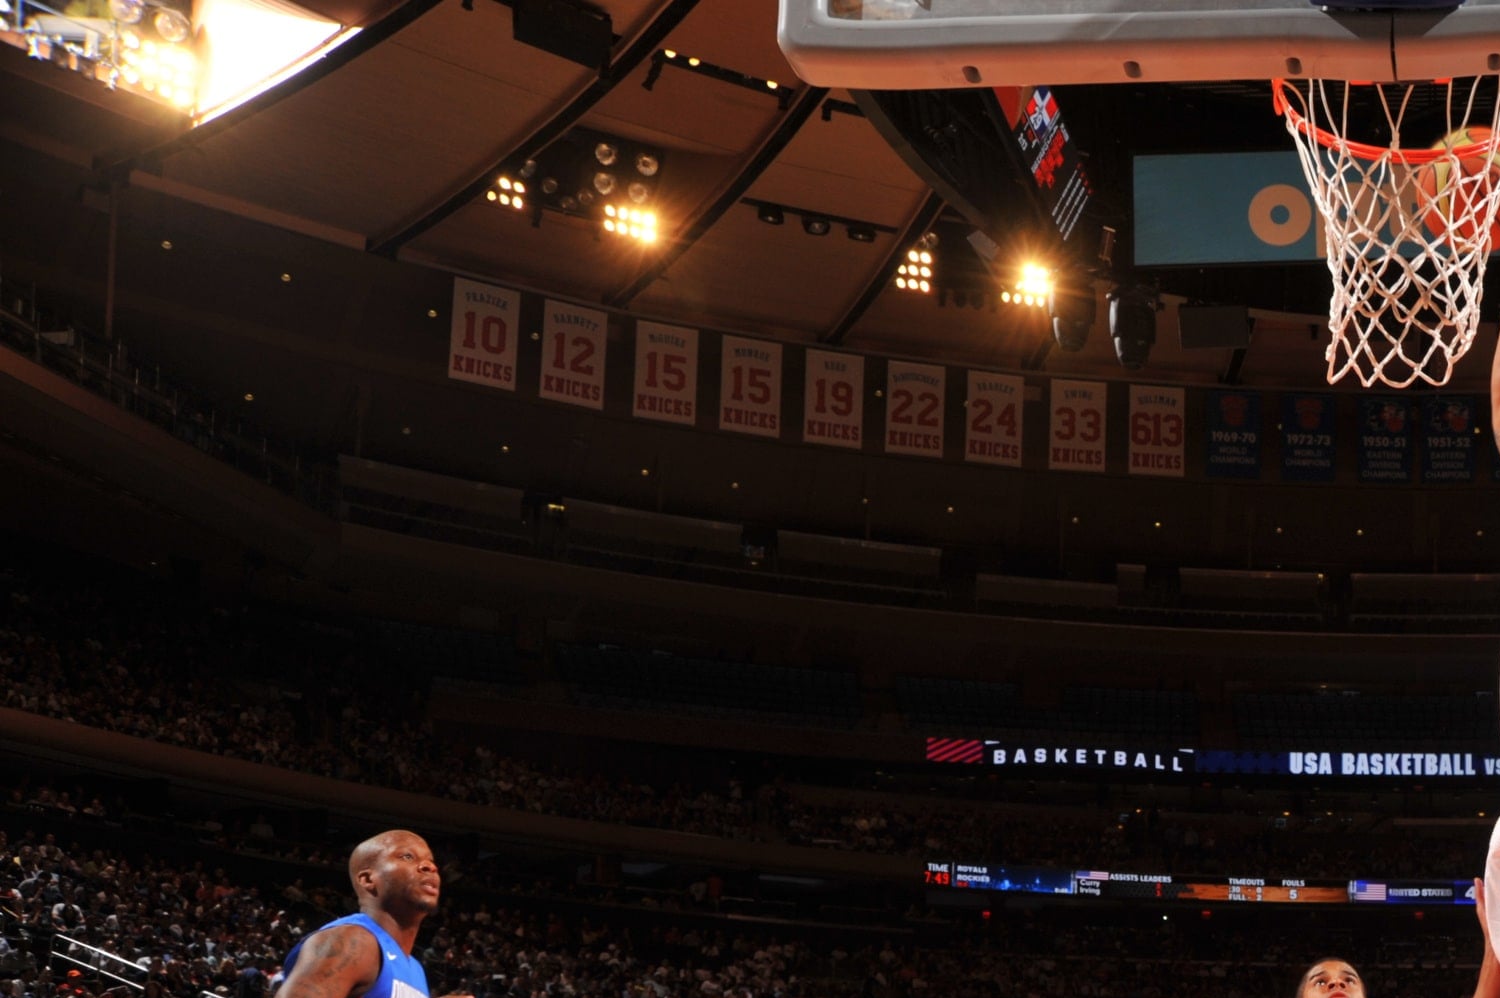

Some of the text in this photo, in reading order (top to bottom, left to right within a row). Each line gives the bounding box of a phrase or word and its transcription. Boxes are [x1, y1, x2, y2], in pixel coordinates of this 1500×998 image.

[462, 311, 507, 355] 10
[552, 332, 596, 376] 12
[453, 353, 513, 382] KNICKS
[645, 351, 687, 392] 15
[543, 374, 601, 401] KNICKS
[731, 365, 772, 405] 15
[636, 394, 693, 417] KNICKS
[815, 378, 854, 416] 19
[891, 389, 939, 428] 22
[723, 407, 777, 430] KNICKS
[971, 398, 1017, 437] 24
[1054, 406, 1101, 443] 33
[806, 419, 859, 442] KNICKS
[888, 430, 941, 451] KNICKS
[1131, 411, 1183, 448] 613
[1212, 431, 1256, 444] 1969-70
[968, 439, 1019, 460] KNICKS
[1052, 447, 1103, 466] KNICKS
[1132, 452, 1181, 471] KNICKS
[993, 748, 1183, 772] BASKETBALL
[1289, 752, 1332, 775] USA
[1341, 753, 1476, 775] BASKETBALL
[928, 862, 949, 872] TIME
[1110, 873, 1172, 883] ASSISTS LEADERS
[1080, 879, 1100, 888] Curry
[1080, 887, 1101, 896] Irving
[1228, 878, 1265, 886] TIMEOUTS
[1389, 888, 1452, 897] UNITED STATES
[1229, 893, 1245, 901] FULL
[1289, 889, 1298, 900] 5
